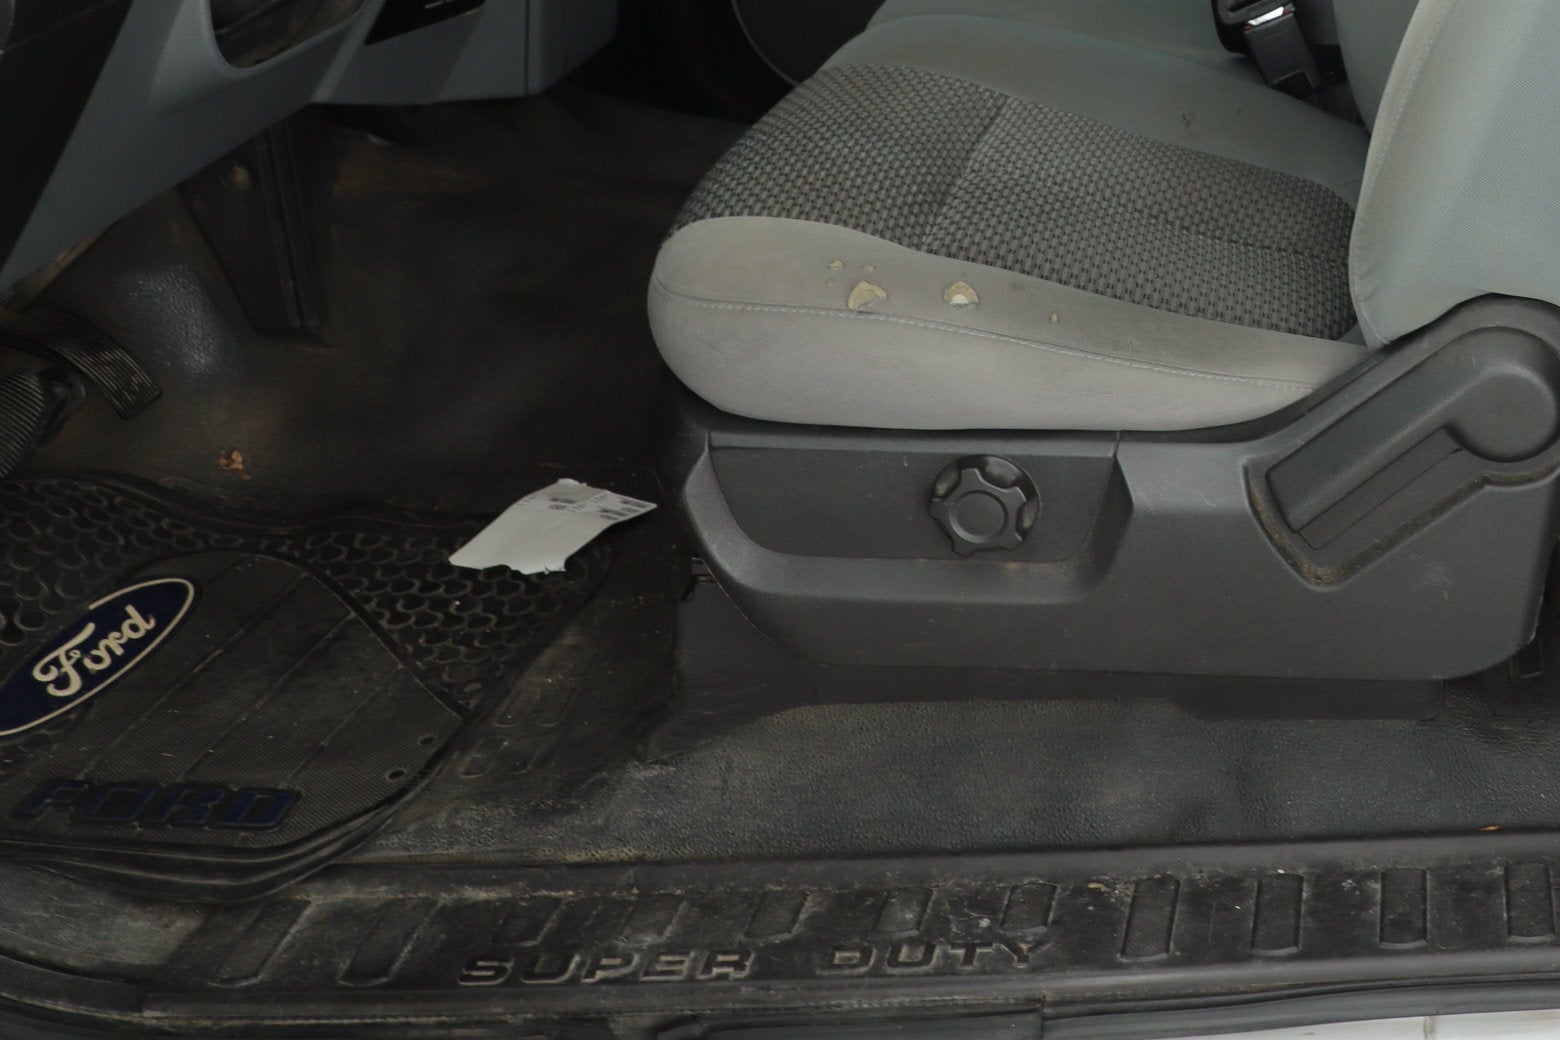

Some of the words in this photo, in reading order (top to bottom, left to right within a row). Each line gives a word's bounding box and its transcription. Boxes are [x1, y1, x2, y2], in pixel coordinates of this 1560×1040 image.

[32, 604, 156, 697] Ford
[15, 778, 301, 829] FORD
[457, 948, 756, 985] SUPER
[821, 939, 1043, 974] DUTY
